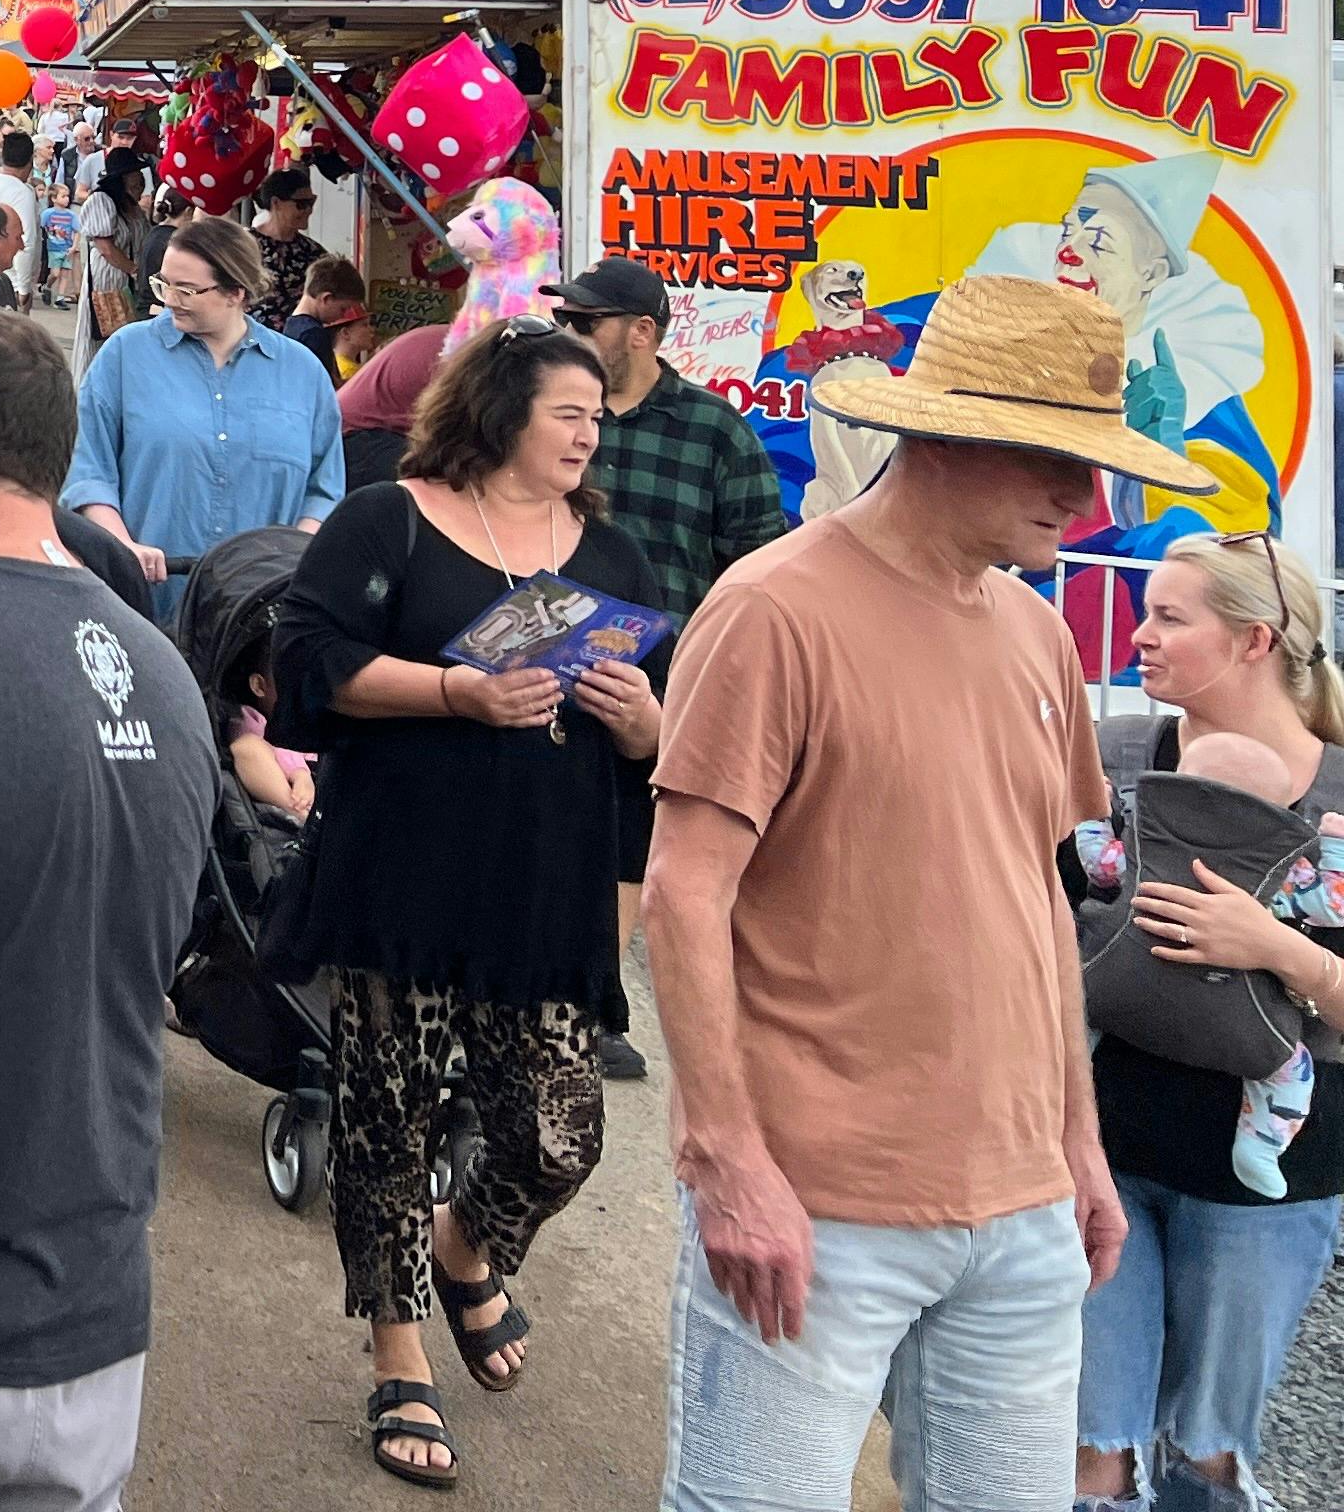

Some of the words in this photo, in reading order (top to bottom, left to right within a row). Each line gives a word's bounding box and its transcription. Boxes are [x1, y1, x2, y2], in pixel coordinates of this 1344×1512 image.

[615, 26, 1005, 129] FAMILY
[1018, 24, 1289, 158] FUN
[601, 147, 934, 204] AMUSEMENT
[601, 192, 809, 252] HIRE
[378, 287, 409, 302] YOU
[413, 291, 448, 305] CAN
[392, 301, 434, 315] BUY
[700, 310, 752, 346] AREAS
[704, 377, 807, 419] 041
[97, 720, 153, 747] MAUI
